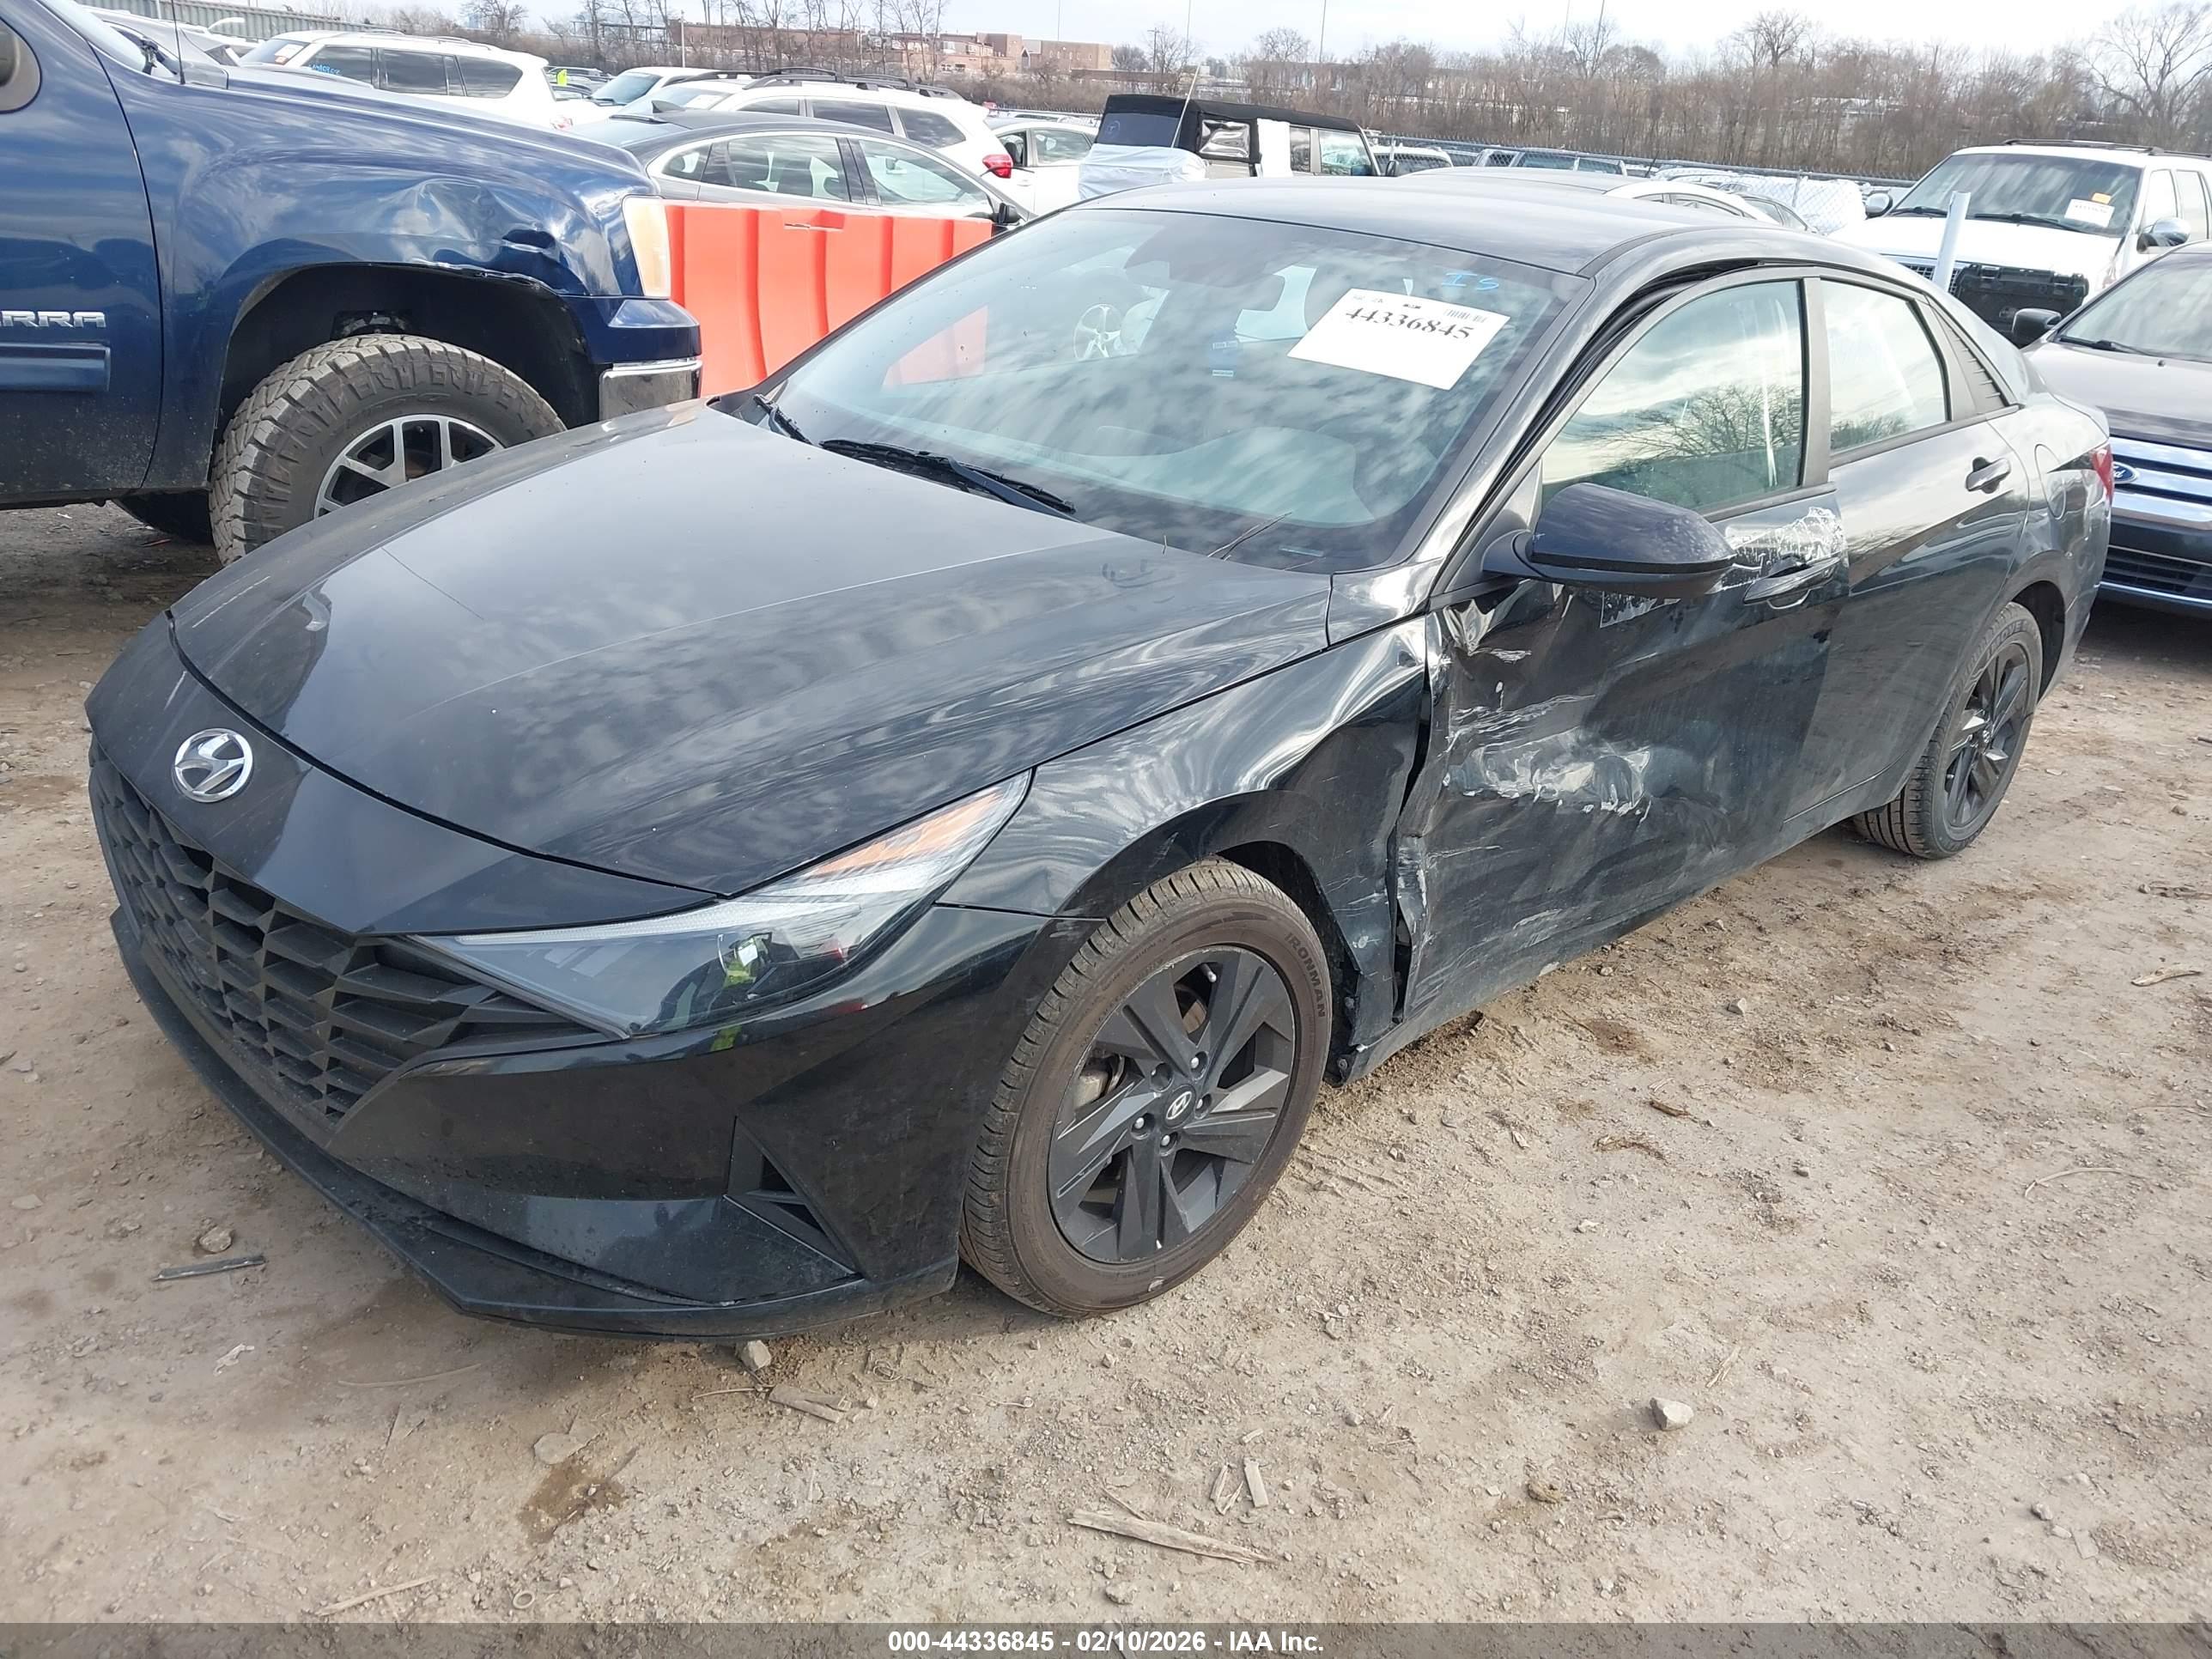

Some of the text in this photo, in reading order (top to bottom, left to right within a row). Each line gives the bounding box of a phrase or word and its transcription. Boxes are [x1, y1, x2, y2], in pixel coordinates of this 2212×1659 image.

[0, 310, 106, 327] RRA
[1345, 307, 1474, 339] 44336845
[1285, 933, 1325, 1017] IRONMAN
